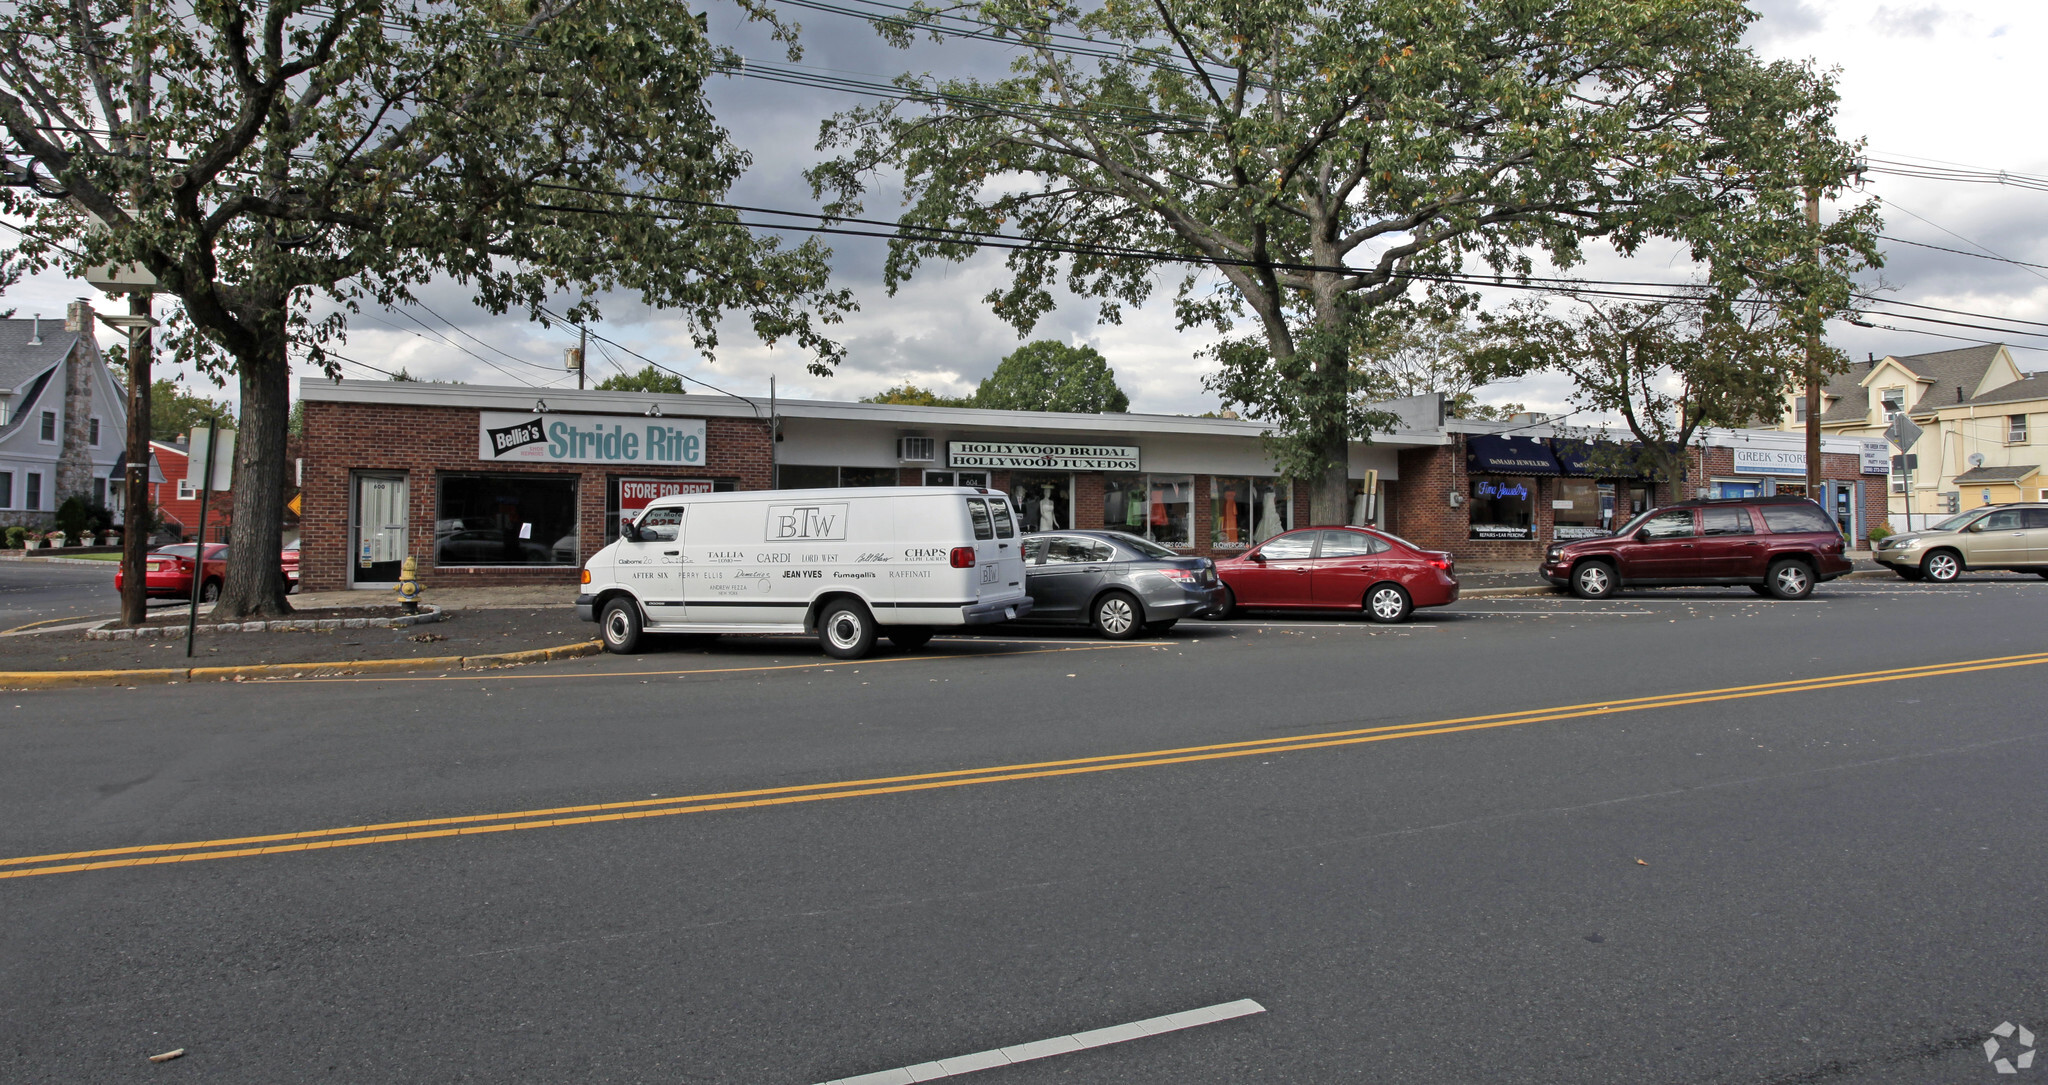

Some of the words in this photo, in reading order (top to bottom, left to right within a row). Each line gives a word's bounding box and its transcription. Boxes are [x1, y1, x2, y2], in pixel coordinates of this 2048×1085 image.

[496, 424, 540, 450] Bellia's
[548, 421, 639, 460] Stride
[645, 425, 700, 463] Rite
[961, 444, 1066, 455] HOLLYWOOD
[1069, 447, 1130, 457] BRIDAL
[1738, 451, 1772, 462] GREEK
[953, 456, 1058, 467] HOLLYWOOD
[1061, 459, 1137, 469] TUXEDOS
[1516, 459, 1550, 467] JEWELERS
[966, 478, 978, 486] 604
[624, 483, 657, 499] STORE
[660, 483, 680, 497] FOR
[1496, 482, 1528, 500] Jewelry
[776, 507, 836, 538] BTW
[756, 553, 791, 563] CARDI
[801, 554, 819, 562] LORD
[821, 554, 839, 562] WEST
[904, 548, 947, 557] CHAPS
[782, 570, 801, 578] JEAN
[803, 570, 823, 578] YVES
[889, 570, 931, 578] RAFFINATI
